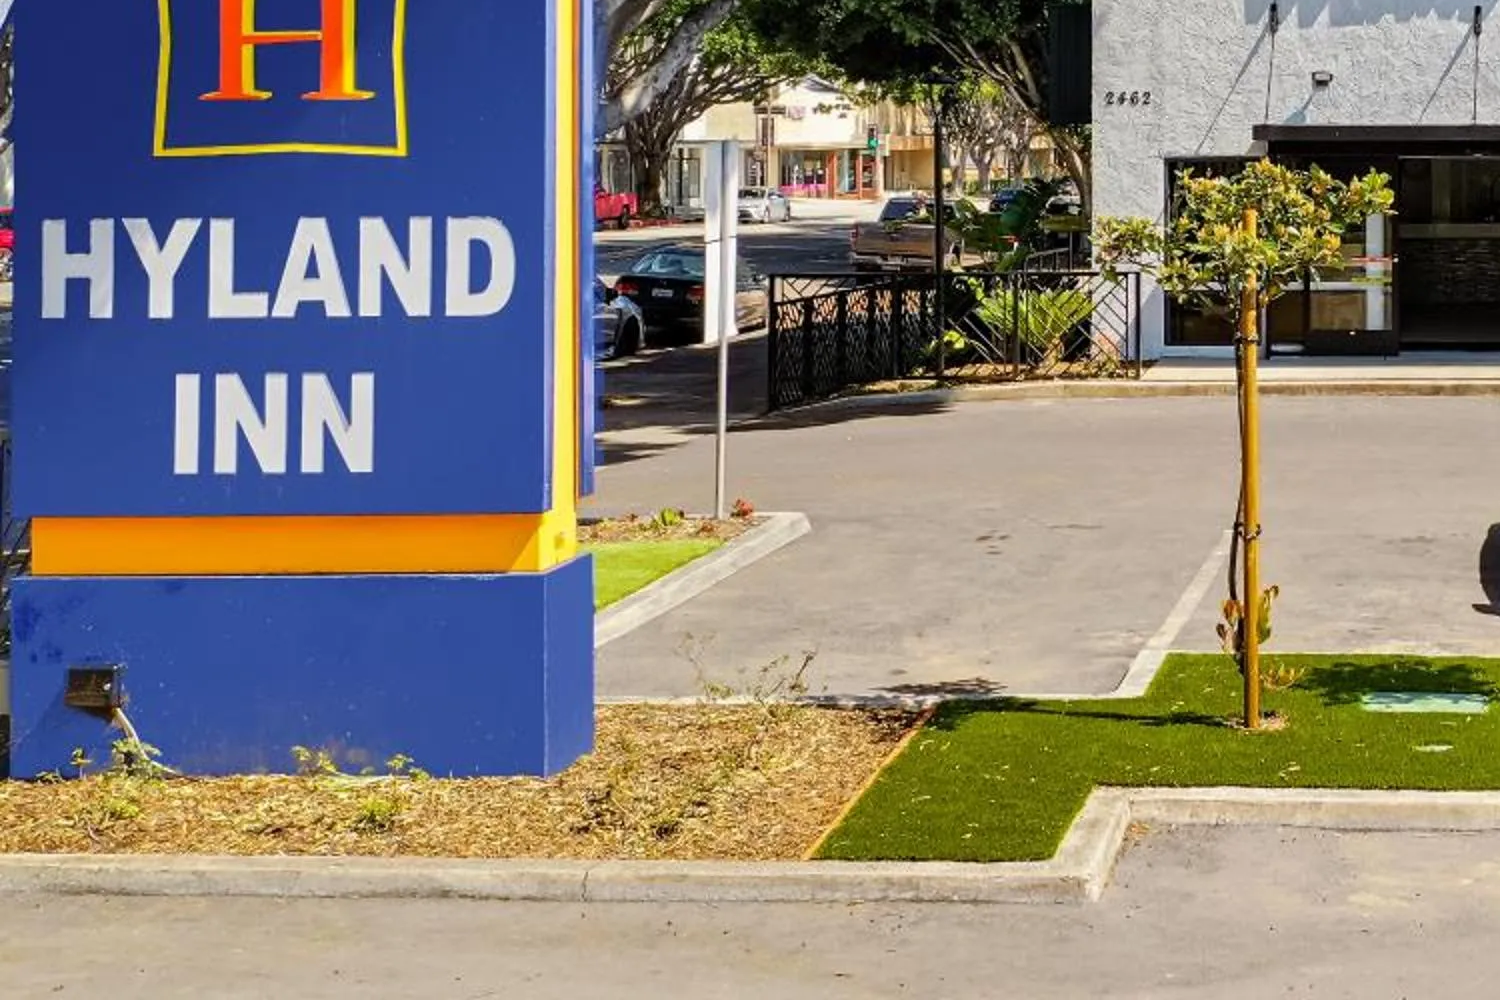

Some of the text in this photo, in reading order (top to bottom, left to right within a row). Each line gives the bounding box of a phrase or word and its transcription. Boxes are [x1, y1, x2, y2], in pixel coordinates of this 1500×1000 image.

[1104, 90, 1152, 106] 2462
[41, 215, 517, 319] HYLAND
[172, 371, 375, 475] INN
